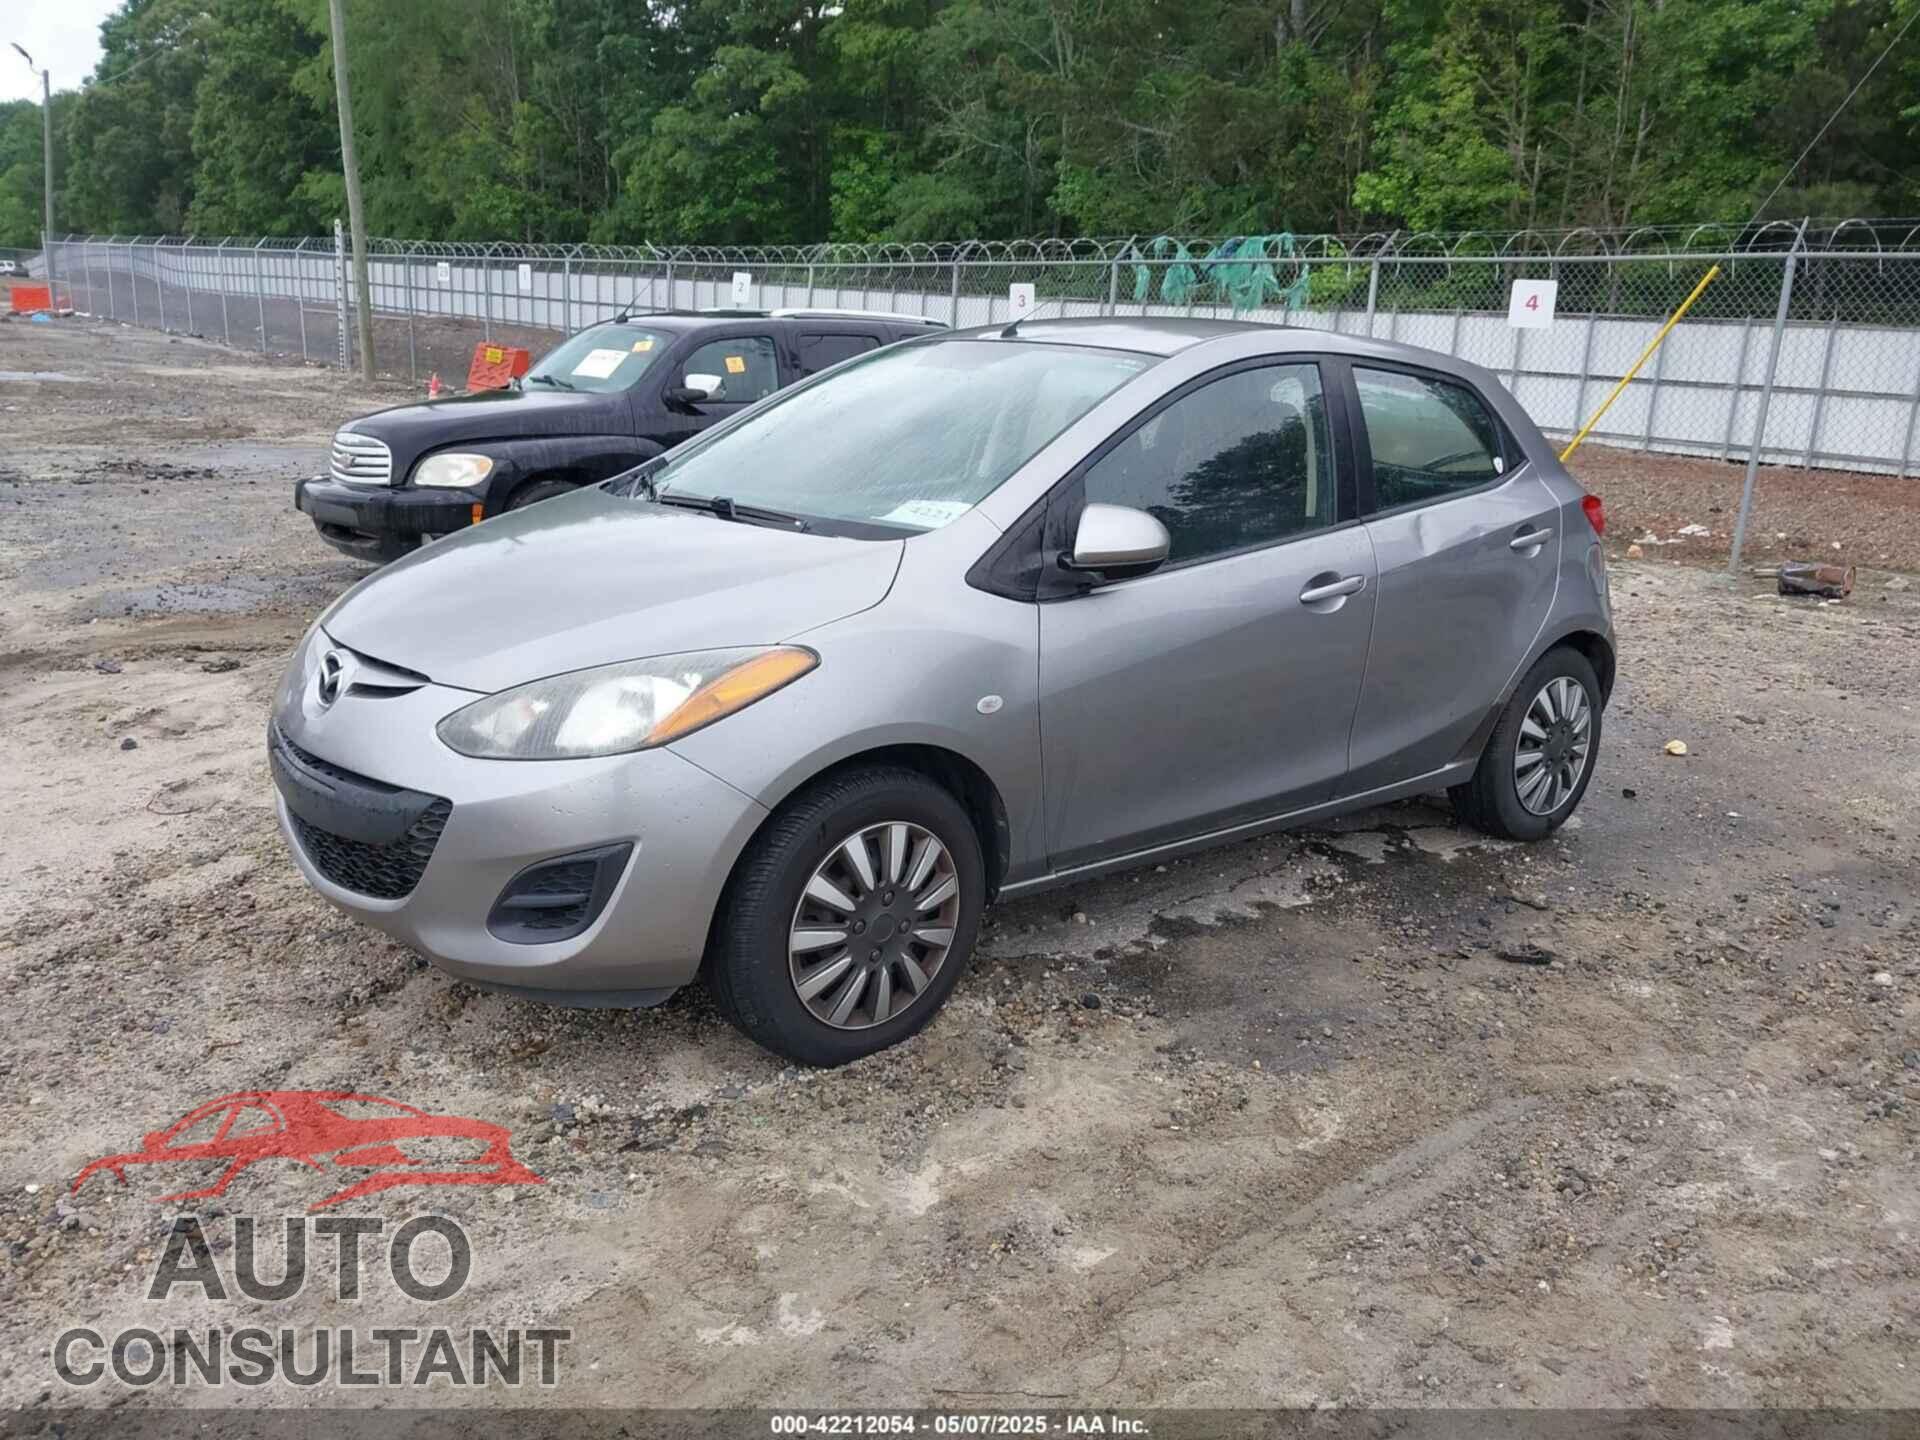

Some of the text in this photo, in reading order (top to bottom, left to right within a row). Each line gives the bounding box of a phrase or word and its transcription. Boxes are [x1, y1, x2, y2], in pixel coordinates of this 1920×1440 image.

[738, 281, 745, 292] 2
[1018, 294, 1026, 308] 3
[1525, 294, 1540, 311] 4
